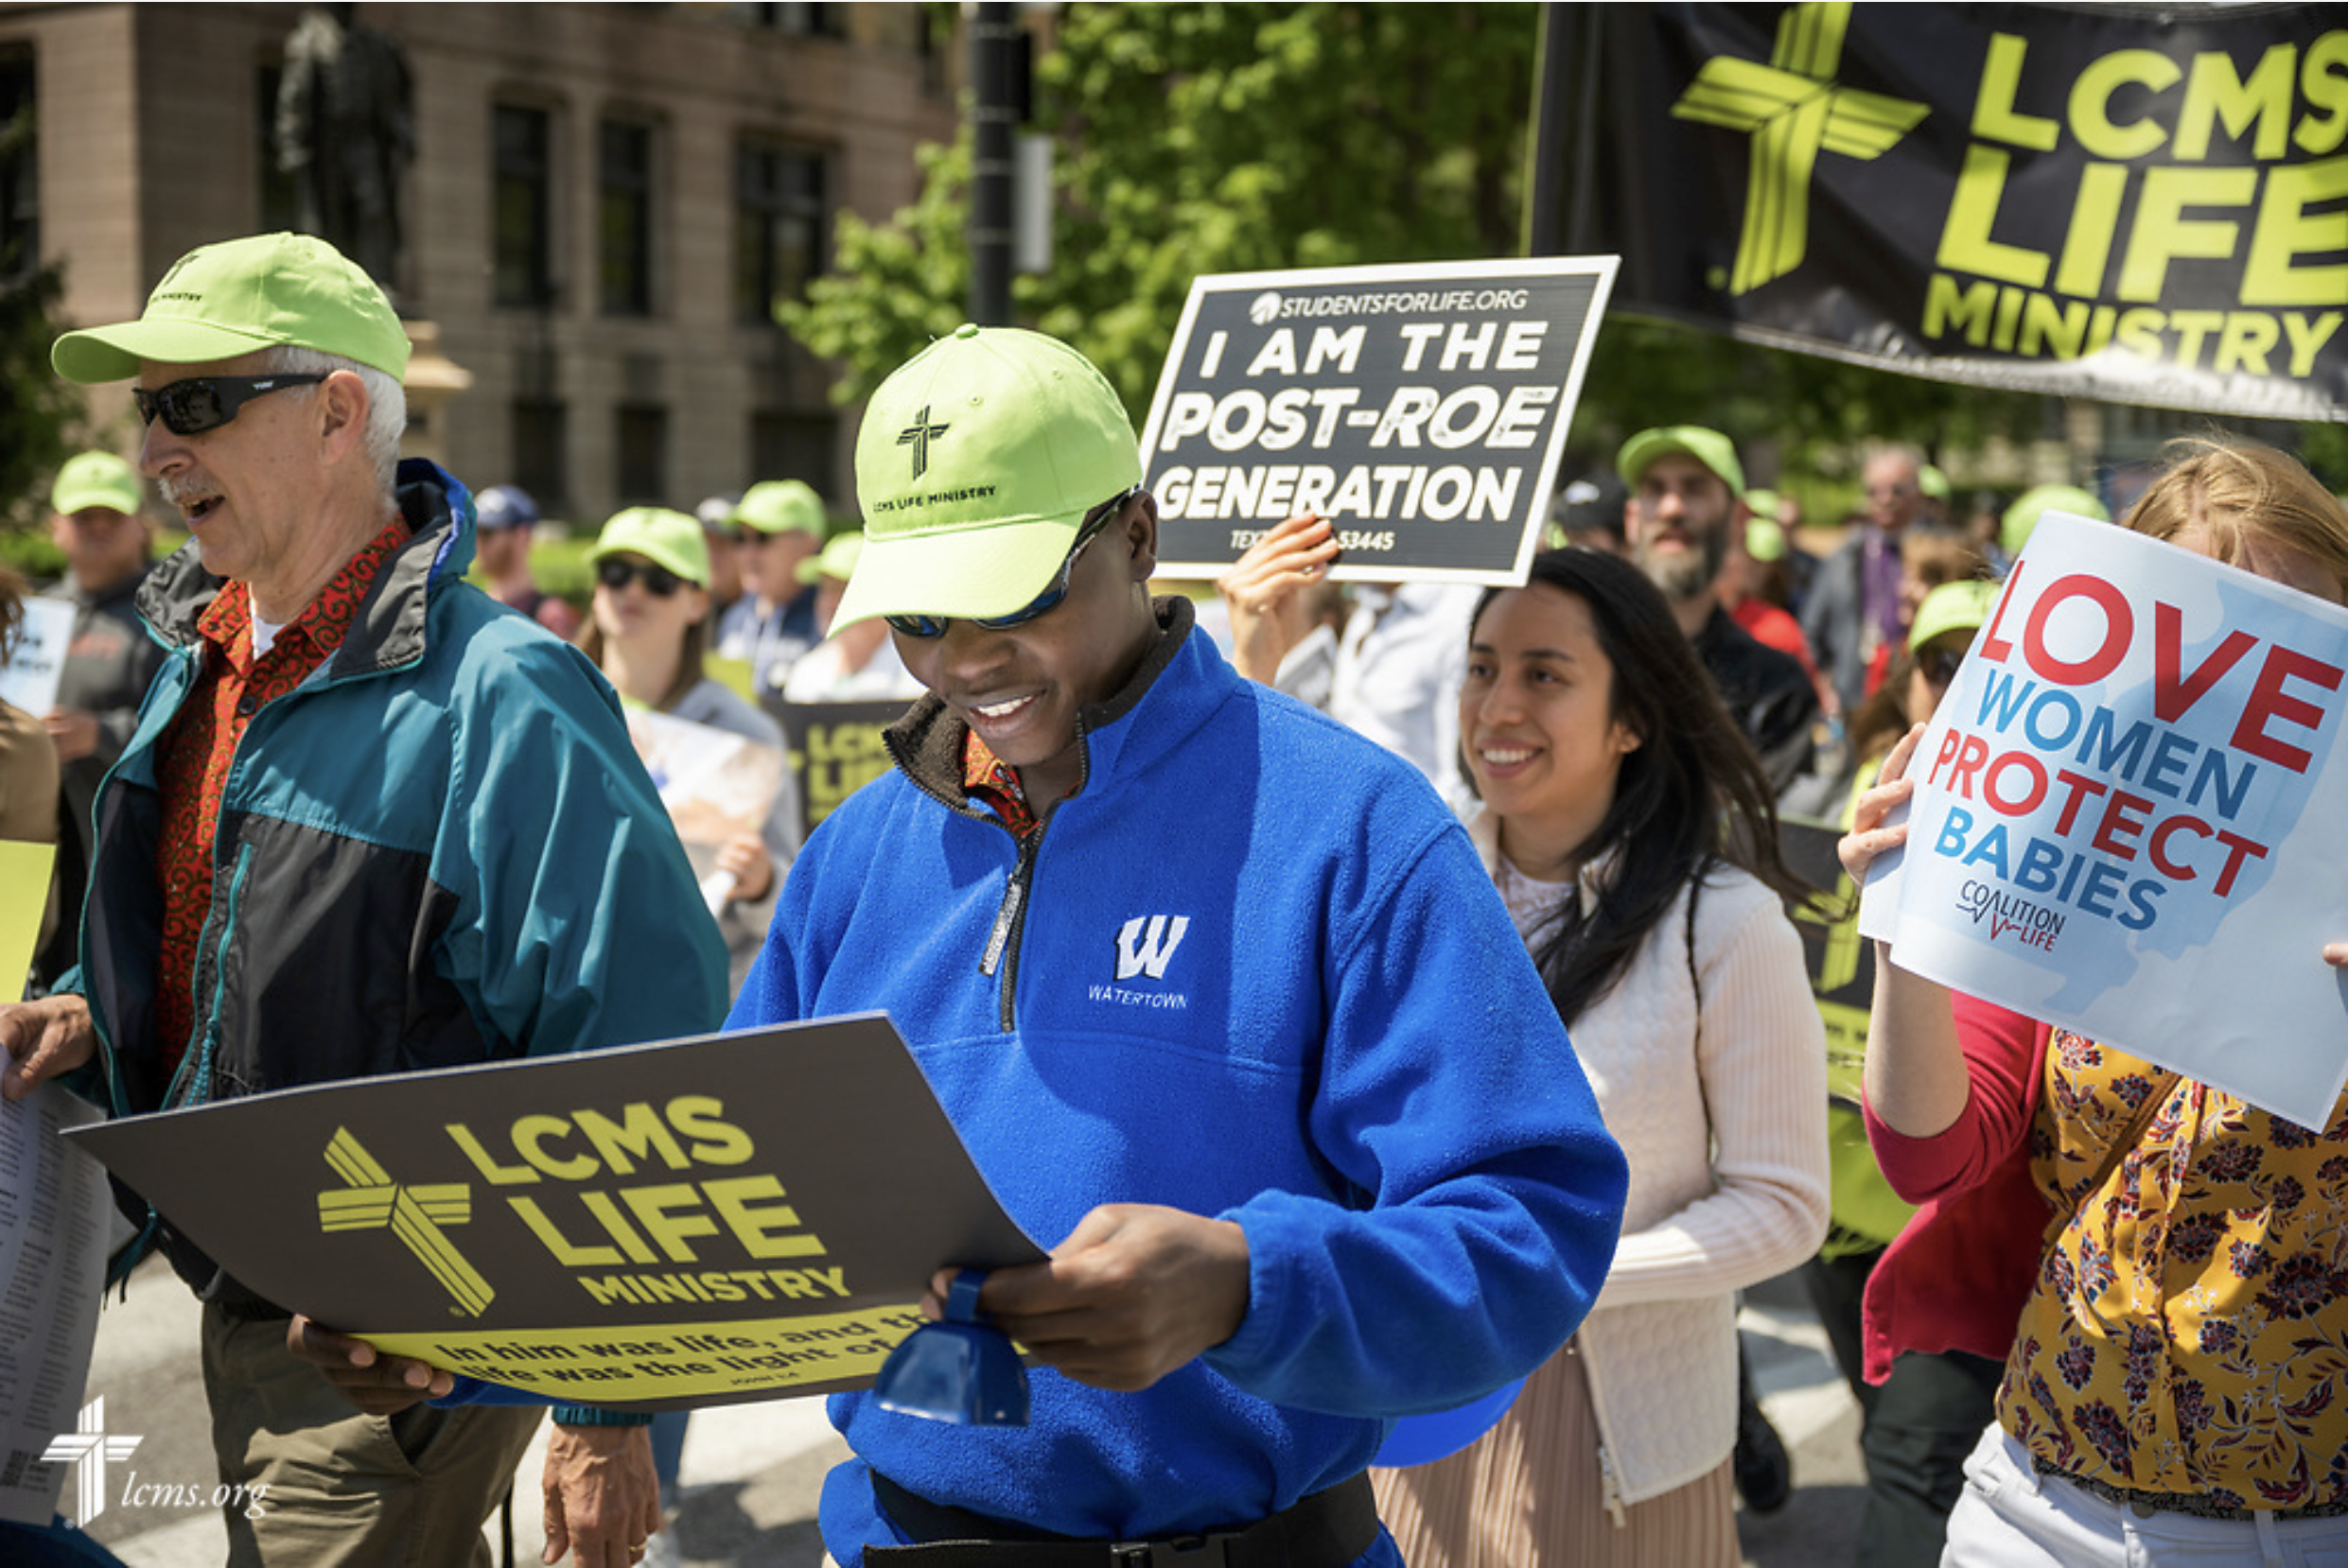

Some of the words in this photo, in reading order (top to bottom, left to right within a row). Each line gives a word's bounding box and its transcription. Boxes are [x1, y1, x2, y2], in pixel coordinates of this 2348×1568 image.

[1971, 29, 2348, 161] LCMS
[1935, 143, 2348, 305] LIFE
[1280, 289, 1529, 318] STUDENTSFORLIFE.ORG
[1921, 273, 2343, 377] MINISTRY
[1200, 331, 1228, 378] I
[1246, 325, 1367, 375] AM
[1400, 321, 1549, 372] THE
[1159, 386, 1559, 452] POST-ROE
[898, 497, 923, 510] LIFE
[927, 485, 996, 505] MINISTRY
[1151, 465, 1522, 521] GENERATION
[1338, 531, 1395, 549] 53445
[1978, 560, 2345, 775] LOVE
[1975, 668, 2258, 822] WOMEN
[1927, 727, 2269, 898] PROTECT
[1934, 806, 2168, 931] BABIES
[1960, 880, 2067, 935] COALITION
[2019, 925, 2058, 953] LIFE
[1088, 984, 1188, 1009] WATERTOWN
[444, 1095, 755, 1186] LCMS
[506, 1175, 828, 1267] LIFE
[577, 1266, 852, 1306] MINISTRY
[433, 1343, 489, 1361] In
[482, 1342, 580, 1360] him
[578, 1341, 675, 1358] was
[671, 1334, 779, 1353] life,
[779, 1321, 878, 1344] and
[542, 1366, 636, 1382] was
[632, 1361, 718, 1376] the
[714, 1348, 839, 1370] light
[845, 1338, 897, 1355] of
